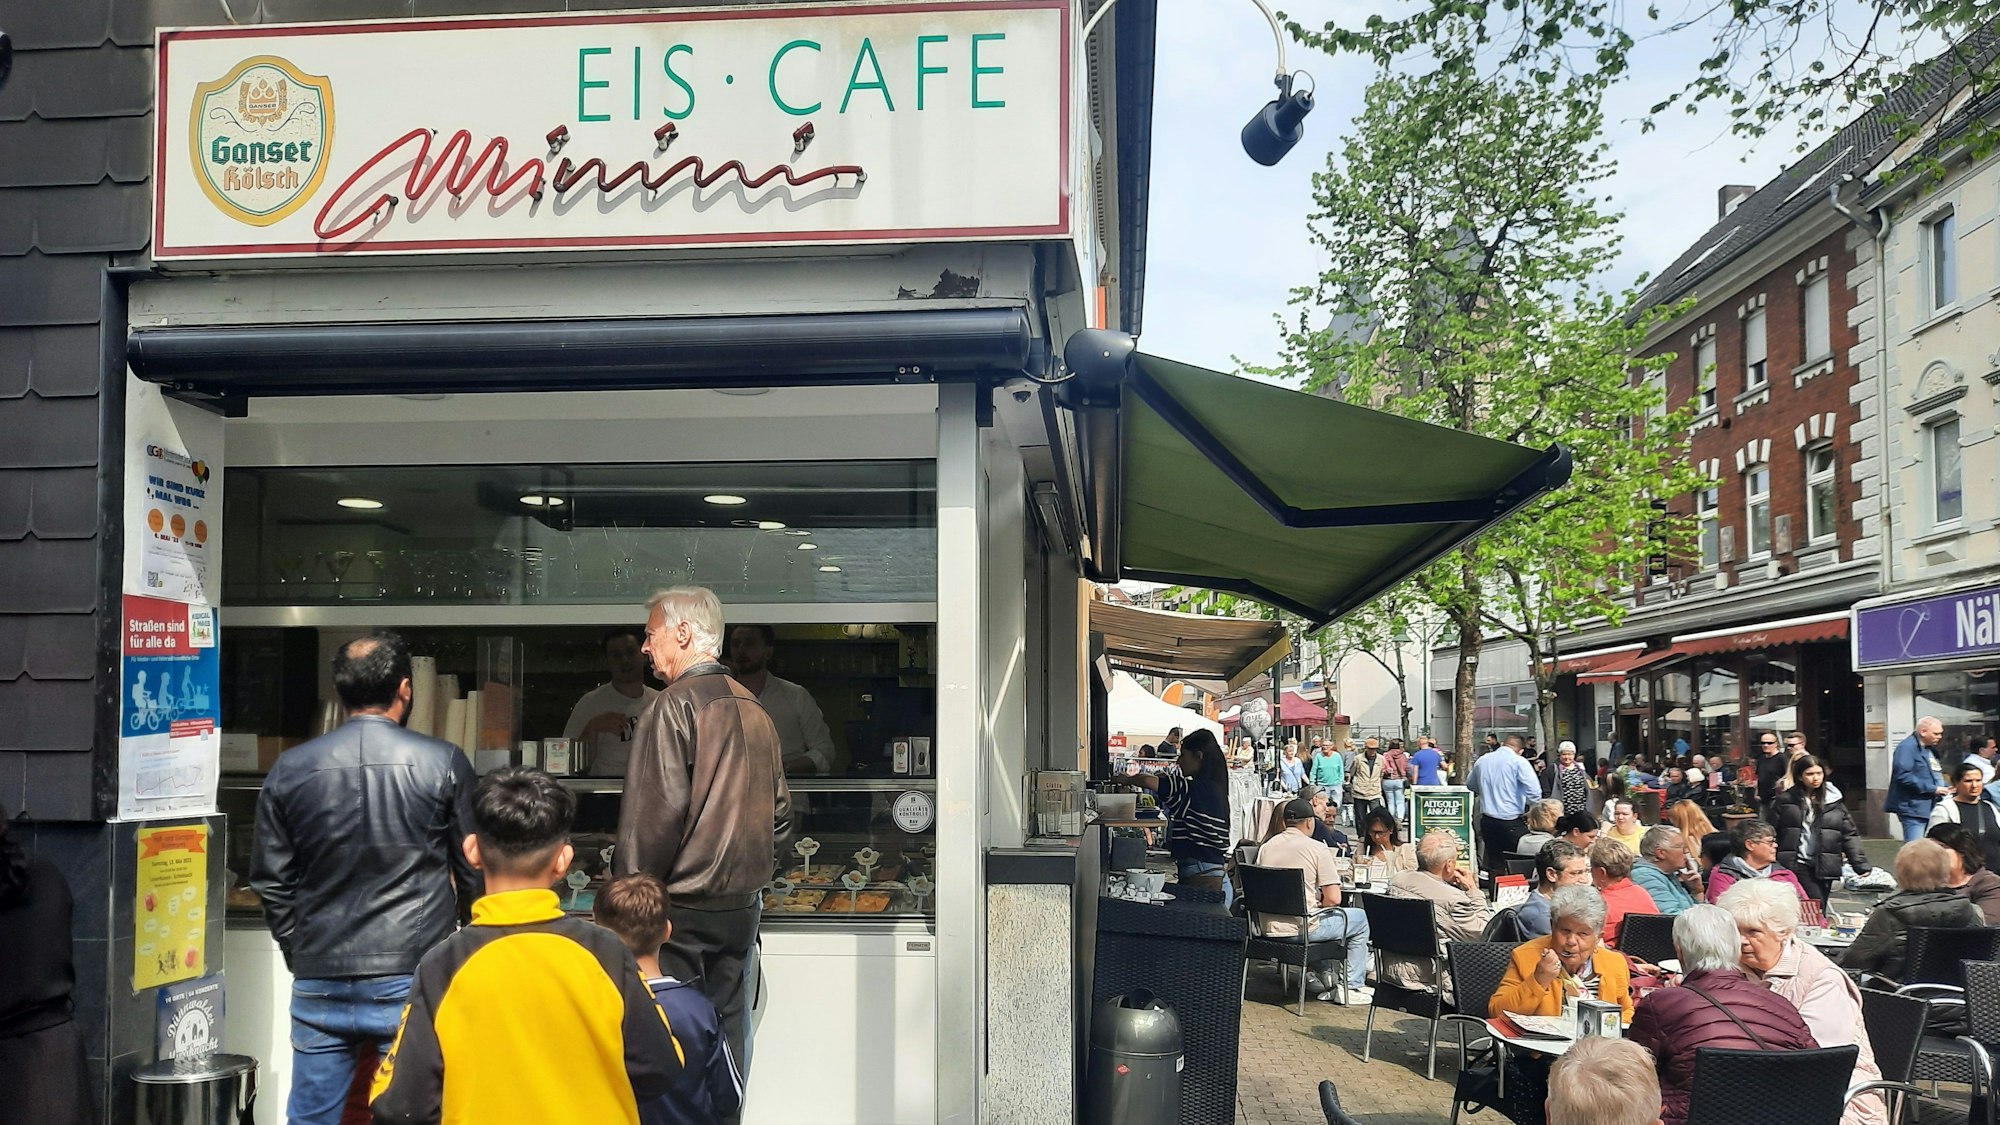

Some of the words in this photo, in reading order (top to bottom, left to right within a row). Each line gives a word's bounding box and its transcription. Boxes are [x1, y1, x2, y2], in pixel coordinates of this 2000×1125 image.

[577, 46, 695, 122] EIS
[768, 33, 1006, 117] CAFE
[211, 136, 313, 166] Ganser
[223, 166, 299, 191] Kölsch
[129, 619, 165, 633] Straßen
[166, 620, 185, 633] sind
[130, 634, 143, 649] für
[145, 635, 163, 649] alle
[164, 636, 176, 649] da
[1424, 800, 1463, 808] ALTGOLD-
[1427, 808, 1460, 816] ANKAUF
[166, 998, 215, 1038] Dünnwalder
